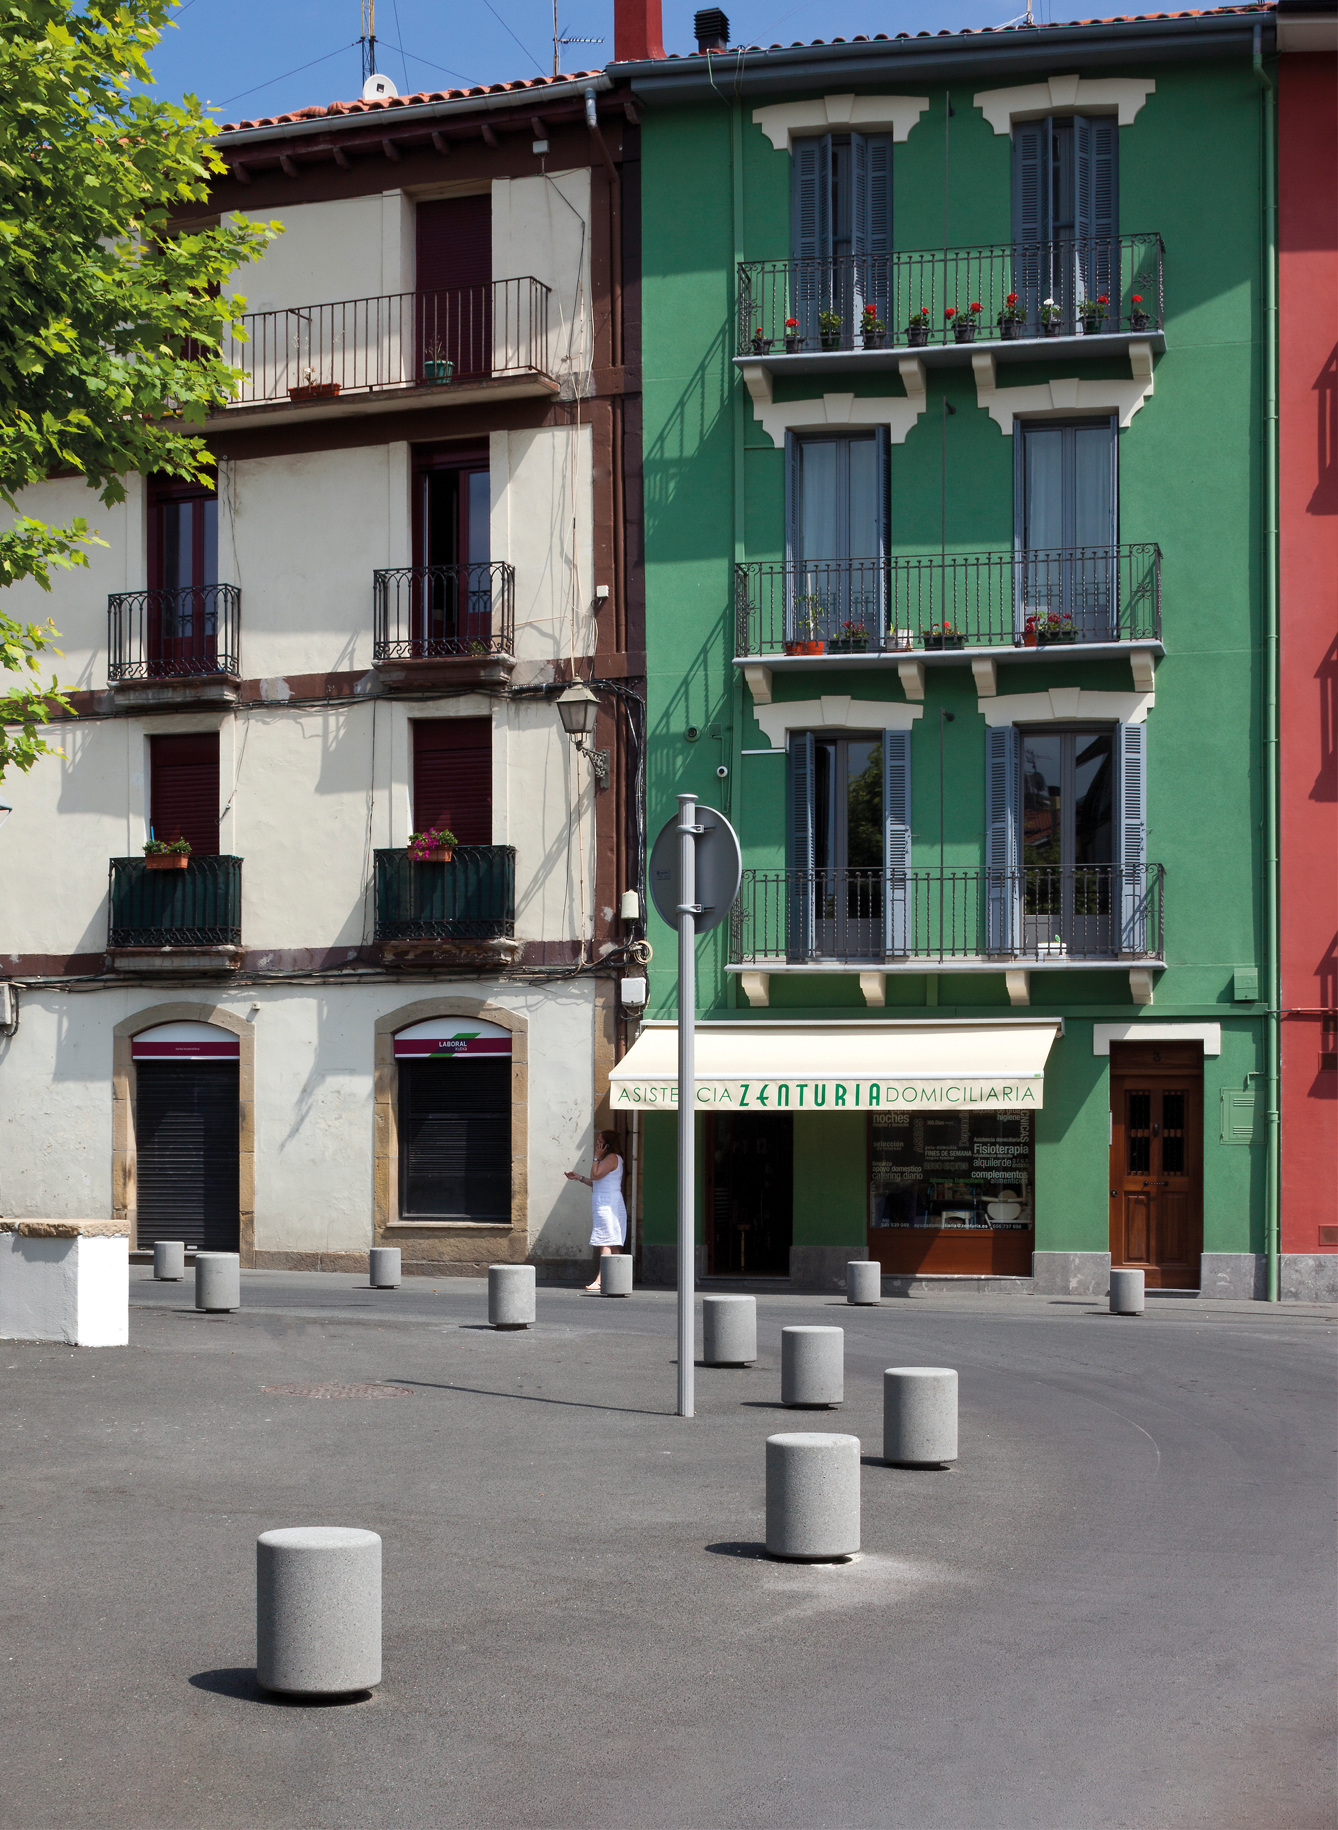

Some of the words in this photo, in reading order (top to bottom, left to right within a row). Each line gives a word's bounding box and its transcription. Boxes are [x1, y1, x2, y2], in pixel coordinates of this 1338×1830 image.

[1153, 1051, 1161, 1062] 3
[618, 1087, 732, 1102] ASISTECIA
[739, 1083, 880, 1107] ZENTURIA
[886, 1086, 1035, 1102] DOMICILIARIA
[873, 1112, 910, 1123] noches
[997, 1113, 1020, 1122] higiene
[973, 1143, 1029, 1156] Fisioterapia
[872, 1172, 901, 1181] catering
[902, 1172, 923, 1180] diario
[971, 1169, 1028, 1180] complementos
